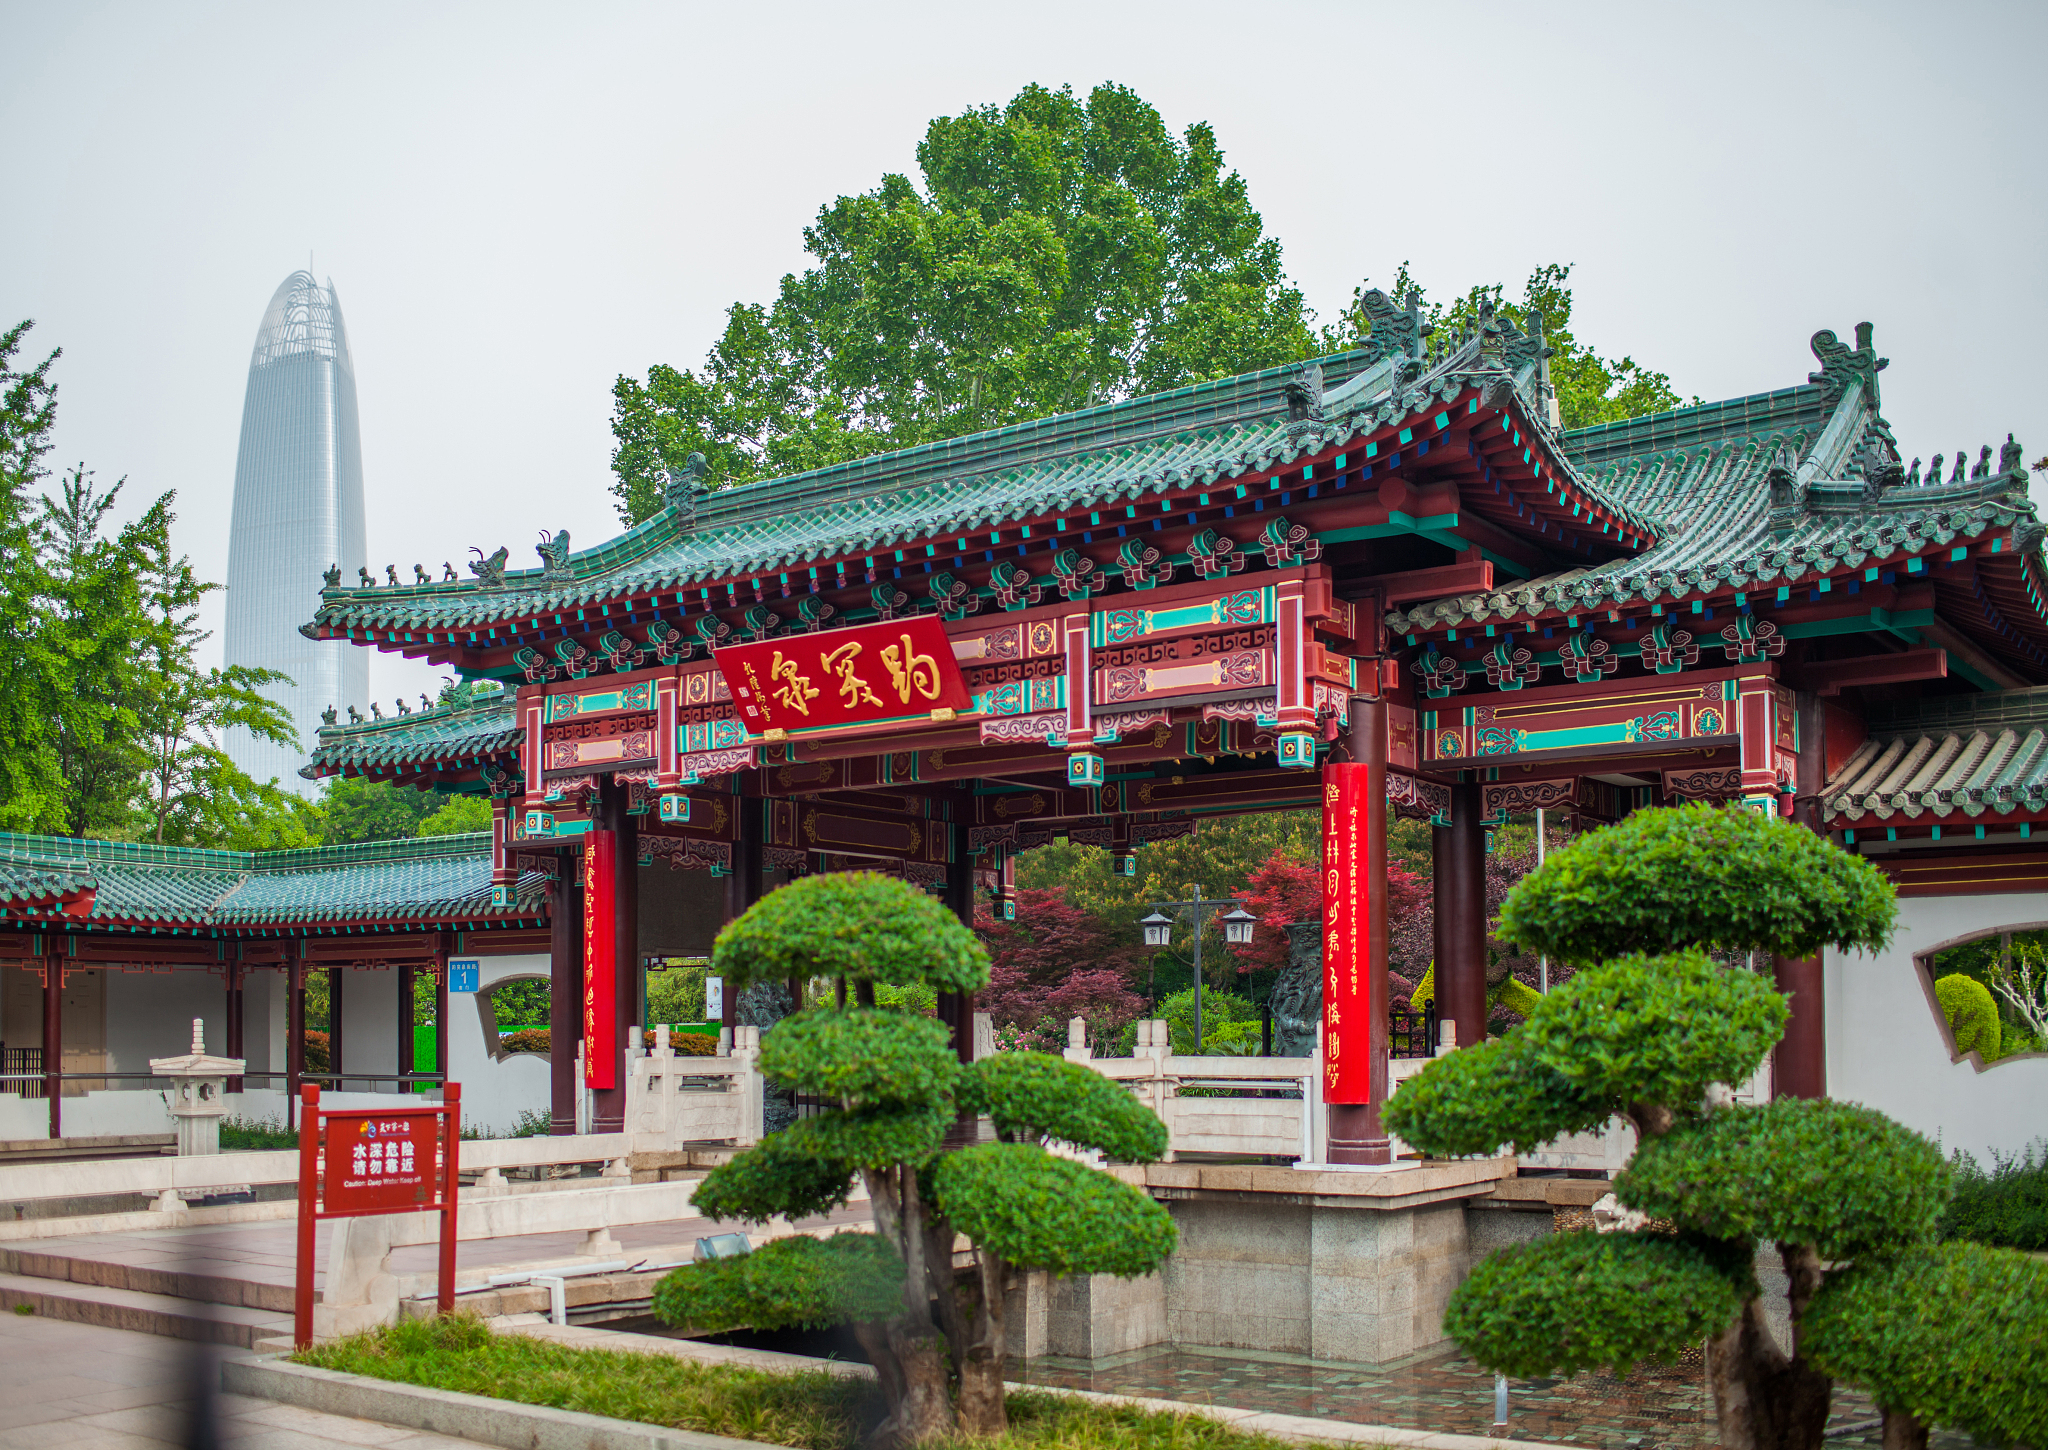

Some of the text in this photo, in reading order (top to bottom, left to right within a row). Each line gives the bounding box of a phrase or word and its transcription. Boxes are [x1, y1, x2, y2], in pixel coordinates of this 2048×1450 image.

[461, 971, 467, 984] 1
[353, 1141, 415, 1159] 水深危险
[353, 1158, 414, 1175] 请勿靠近
